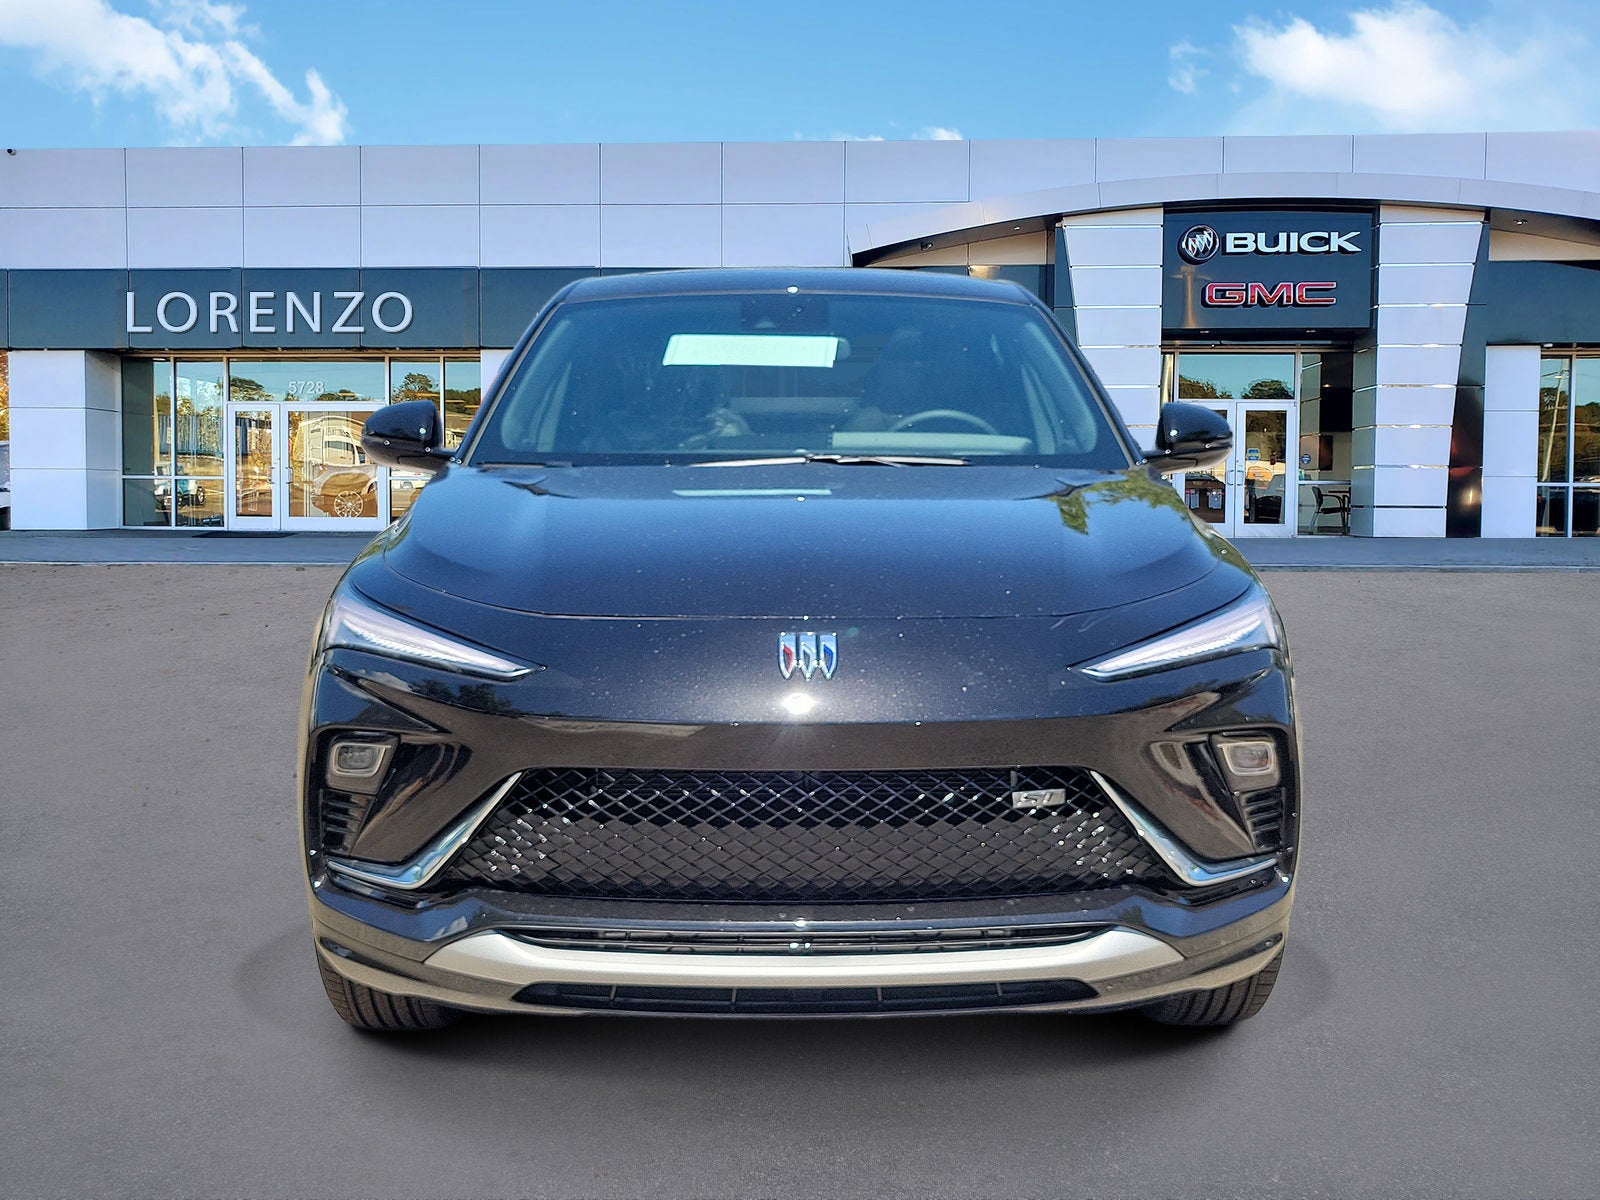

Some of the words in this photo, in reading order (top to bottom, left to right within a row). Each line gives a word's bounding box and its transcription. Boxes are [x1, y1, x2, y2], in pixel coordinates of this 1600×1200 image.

[1225, 231, 1361, 253] BUICK
[1206, 282, 1336, 305] GMC
[126, 291, 413, 333] LORENZO
[288, 380, 325, 394] 5728
